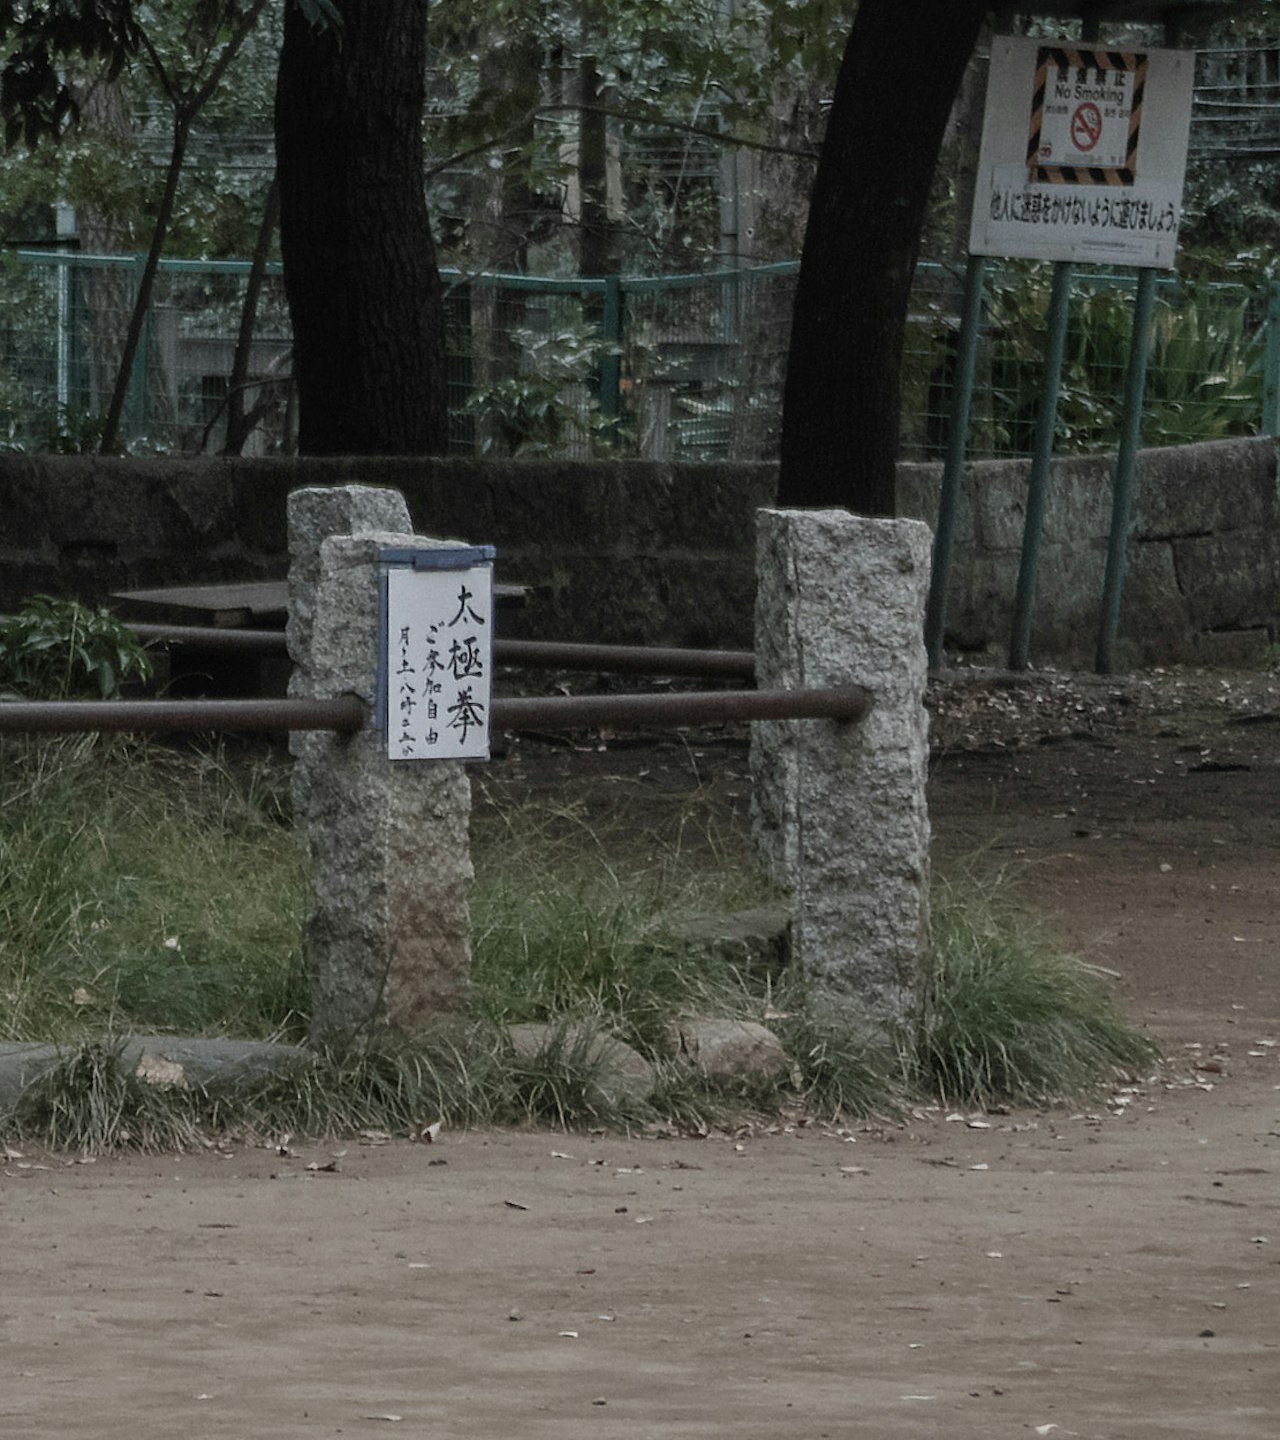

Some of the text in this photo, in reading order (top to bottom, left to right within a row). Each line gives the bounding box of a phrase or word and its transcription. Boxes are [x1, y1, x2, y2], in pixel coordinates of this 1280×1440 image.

[1055, 85, 1124, 106] No Smoking
[422, 622, 445, 746] ご参加自由
[446, 584, 485, 745] 太極拳
